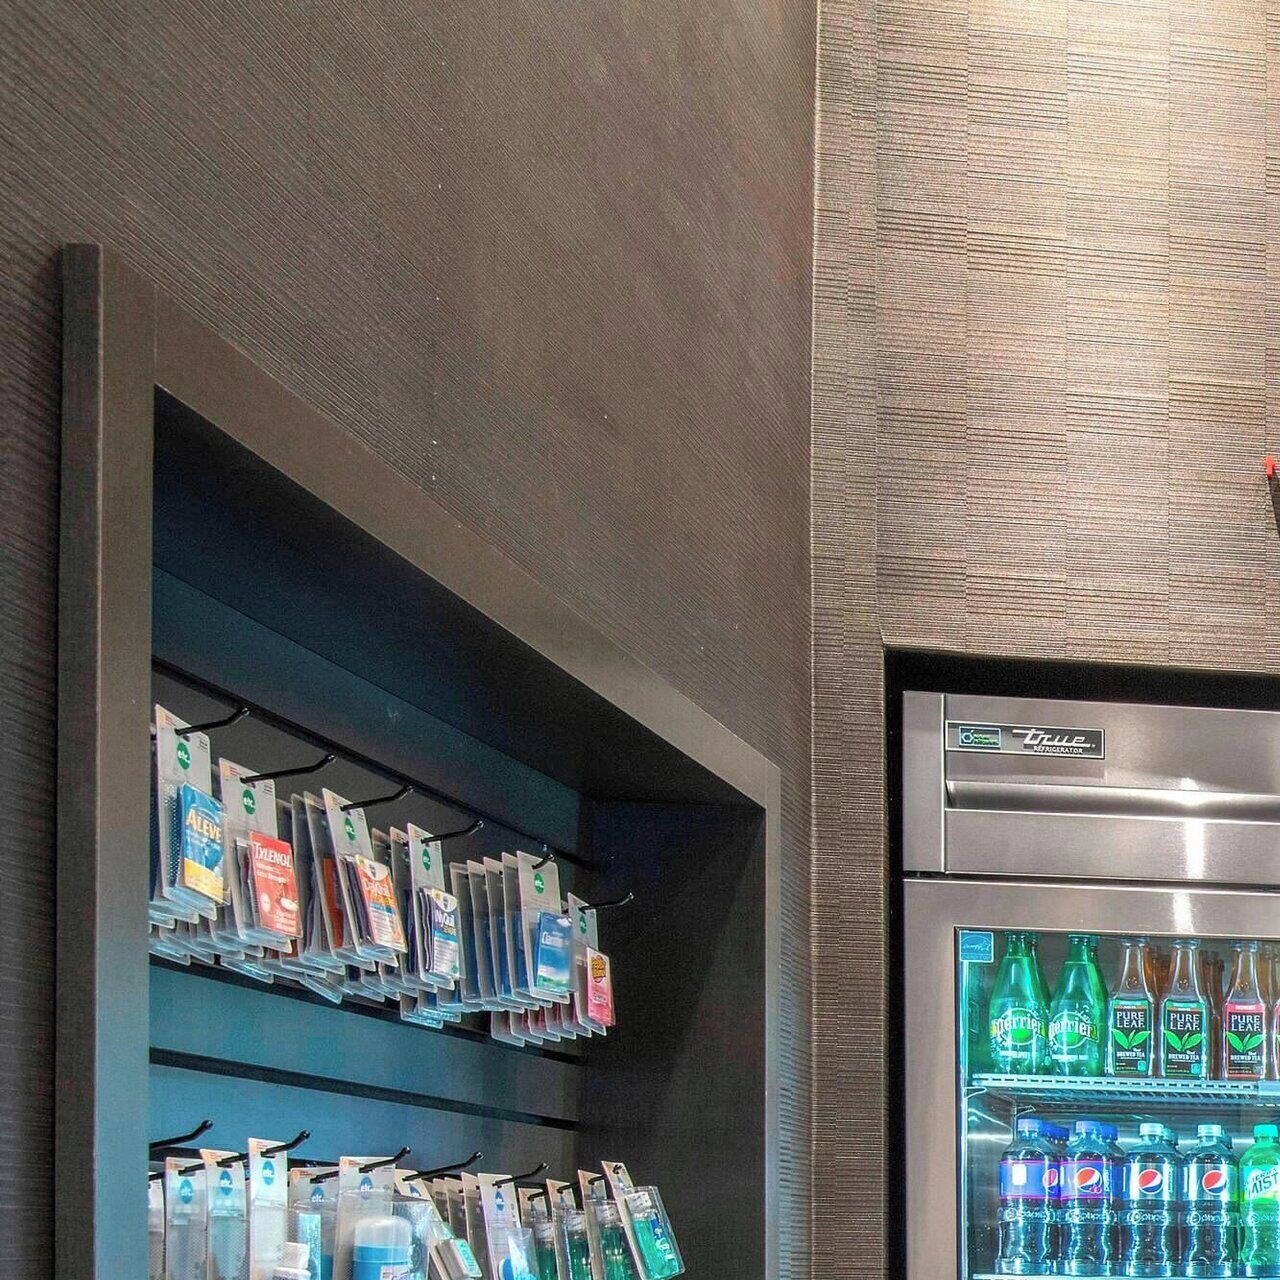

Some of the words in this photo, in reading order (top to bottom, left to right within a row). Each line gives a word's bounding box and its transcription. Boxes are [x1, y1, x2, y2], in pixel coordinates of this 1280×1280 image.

[1033, 745, 1084, 755] REFRIGERATOR
[186, 809, 221, 843] ALEVE
[253, 841, 292, 868] TYLENOL
[1116, 1012, 1145, 1020] PURE
[1170, 1013, 1200, 1022] PURE
[1231, 1014, 1260, 1023] PURE
